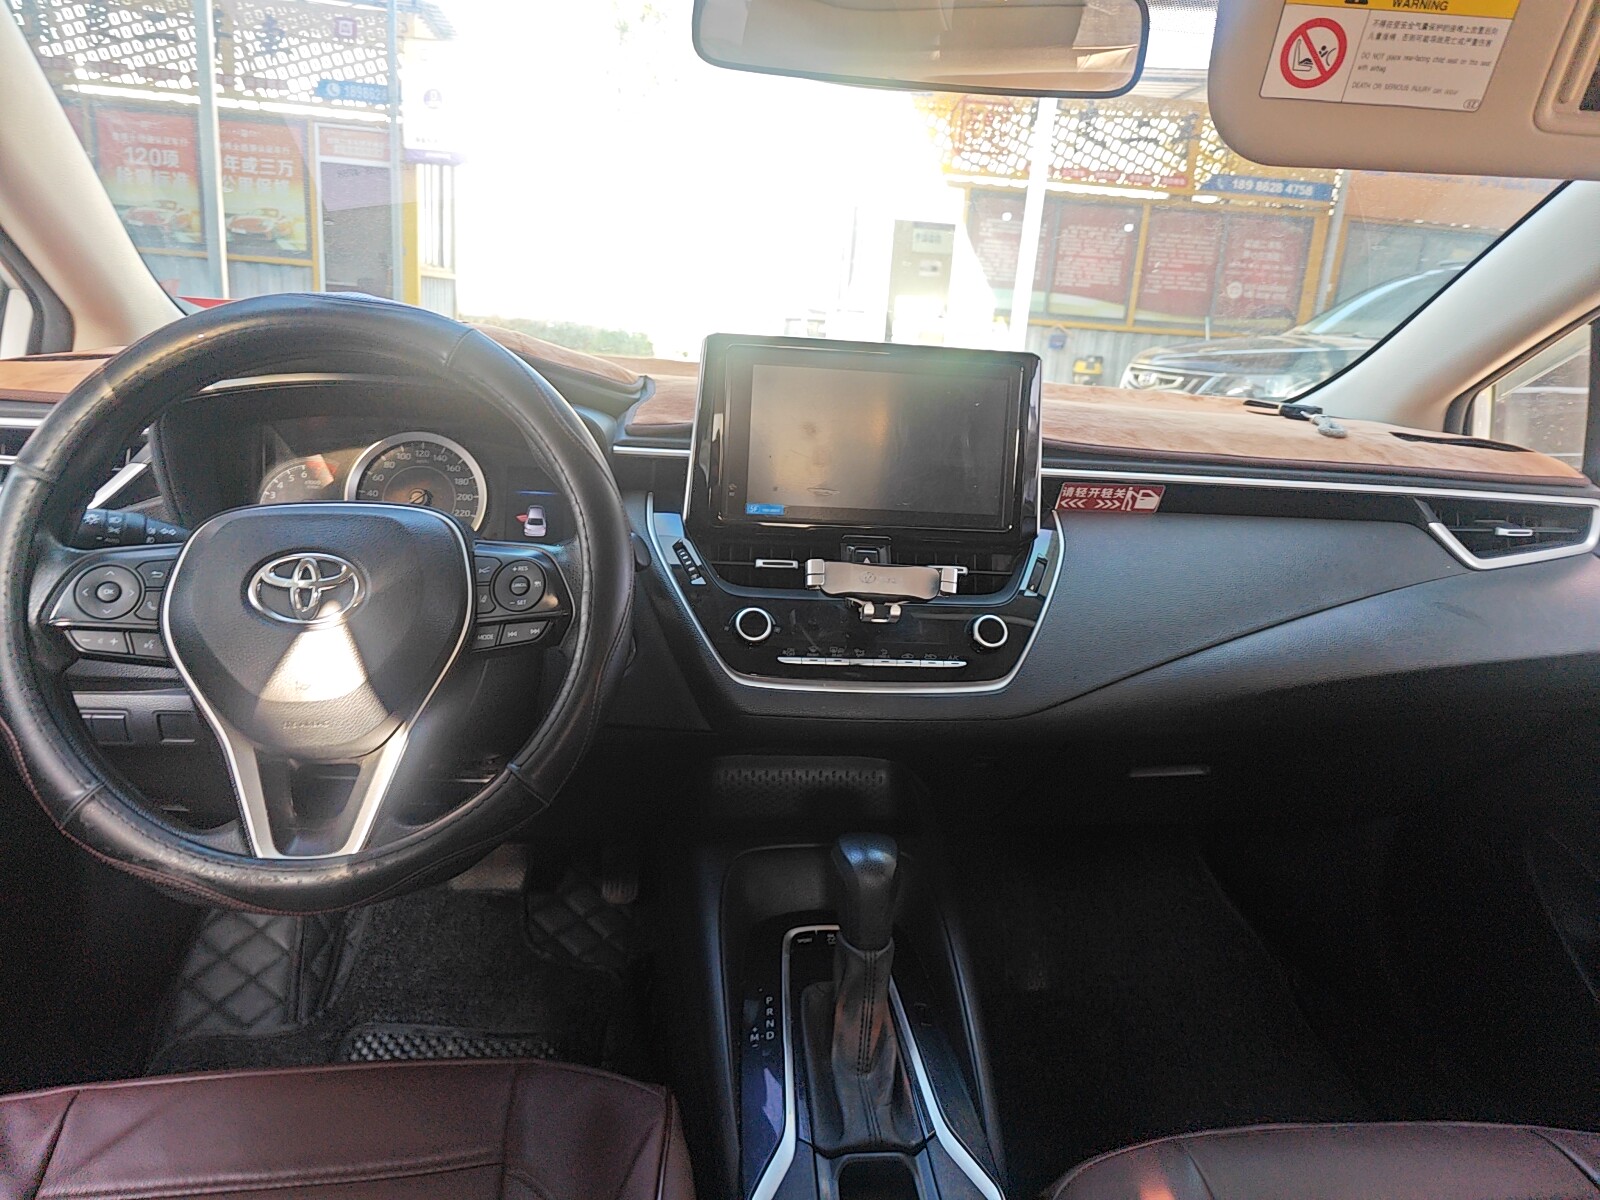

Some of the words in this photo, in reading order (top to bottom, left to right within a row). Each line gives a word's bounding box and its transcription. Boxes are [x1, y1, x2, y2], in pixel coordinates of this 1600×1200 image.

[1392, 0, 1448, 11] WARNING
[1372, 52, 1385, 60] NOT
[1351, 81, 1371, 90] DEATH
[396, 452, 412, 461] 100
[415, 449, 431, 458] 120
[433, 454, 448, 463] 140
[383, 461, 396, 469] 80
[446, 463, 461, 473] 160
[288, 474, 295, 482] 5
[300, 470, 308, 479] 6
[372, 473, 385, 482] 60
[454, 477, 470, 486] 180
[269, 491, 276, 500] 3
[366, 489, 379, 498] 40
[456, 492, 474, 501] 200
[1061, 486, 1126, 499] 请轻开轻关
[454, 509, 471, 517] 220
[765, 996, 773, 1005] P
[765, 1007, 774, 1016] R
[765, 1019, 775, 1028] N
[749, 1033, 760, 1042] M
[765, 1031, 775, 1040] D
